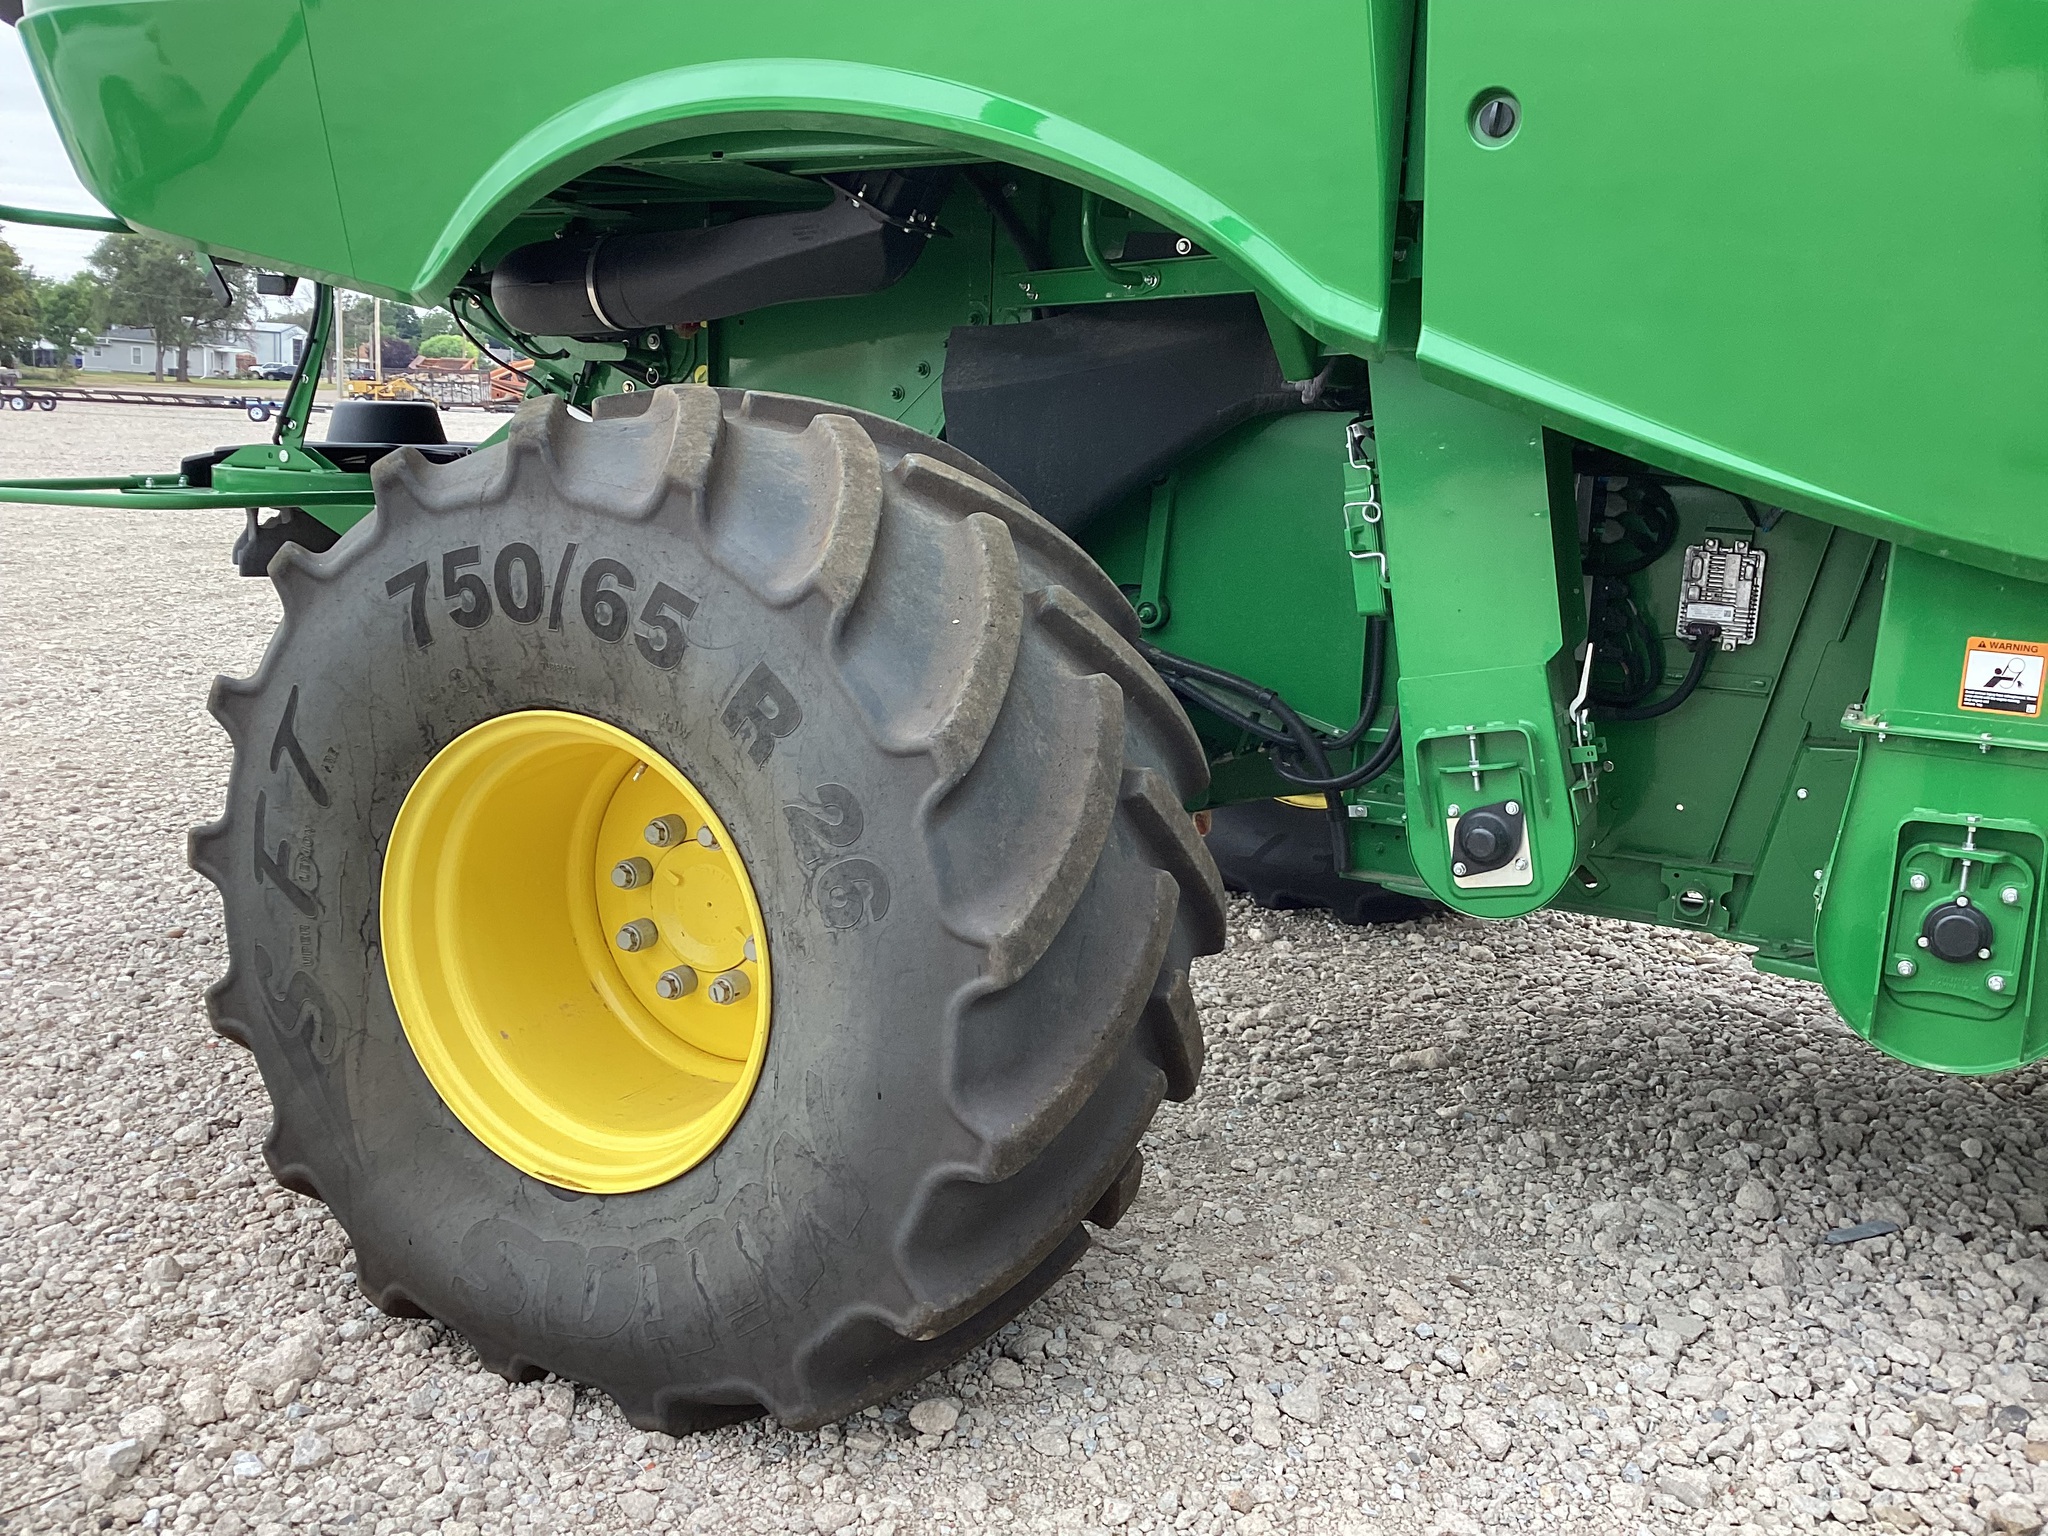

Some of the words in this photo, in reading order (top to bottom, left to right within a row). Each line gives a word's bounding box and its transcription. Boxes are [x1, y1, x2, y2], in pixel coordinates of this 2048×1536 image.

[384, 541, 699, 671] 750/65
[719, 660, 803, 771] R
[782, 782, 890, 929] 26
[1989, 641, 2039, 653] WARNING
